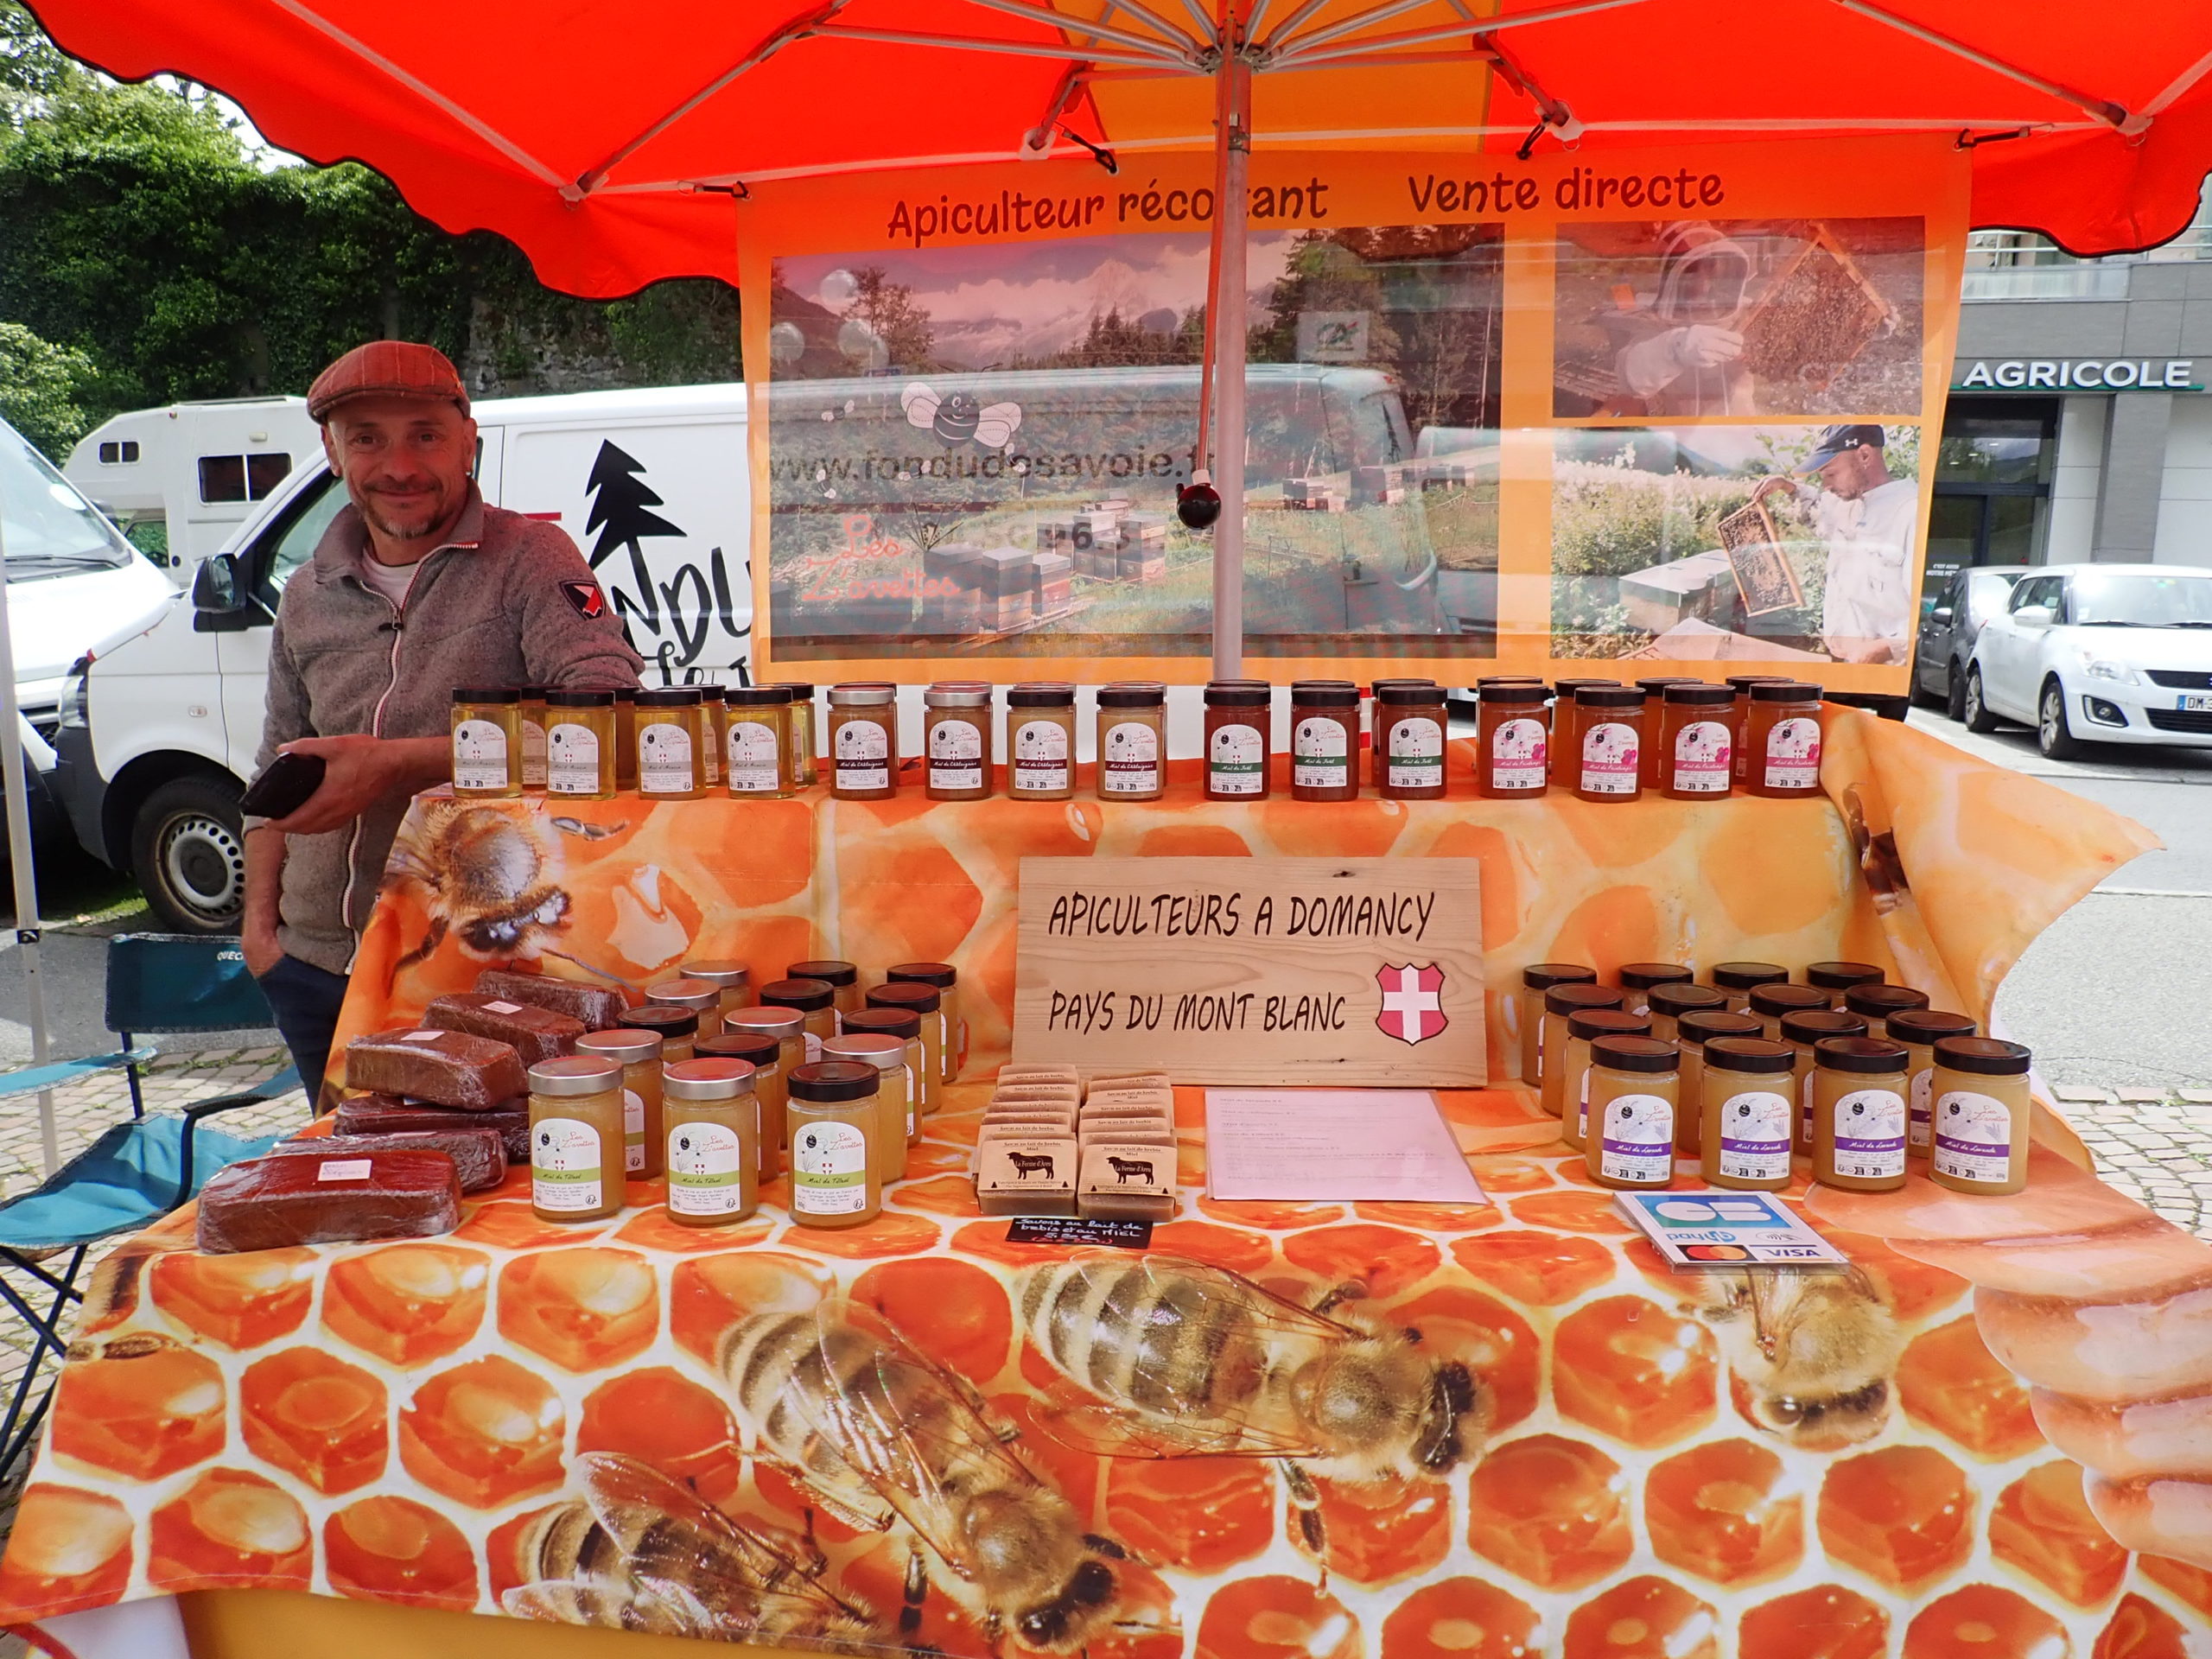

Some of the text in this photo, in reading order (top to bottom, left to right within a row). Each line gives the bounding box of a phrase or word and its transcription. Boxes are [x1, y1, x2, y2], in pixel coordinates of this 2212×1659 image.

[887, 177, 1328, 248] Apiculteur récoant
[1408, 167, 1725, 213] Vente directe
[1961, 359, 2193, 388] AGRICOLE
[839, 515, 906, 561] Les
[1047, 891, 1435, 941] APICULTEURS A DOMANCY
[217, 950, 244, 962] QUEC
[1048, 990, 1345, 1035] PAYS DU MONT BLANC
[1087, 1219, 1118, 1229] lait
[1764, 1249, 1821, 1257] VISA
